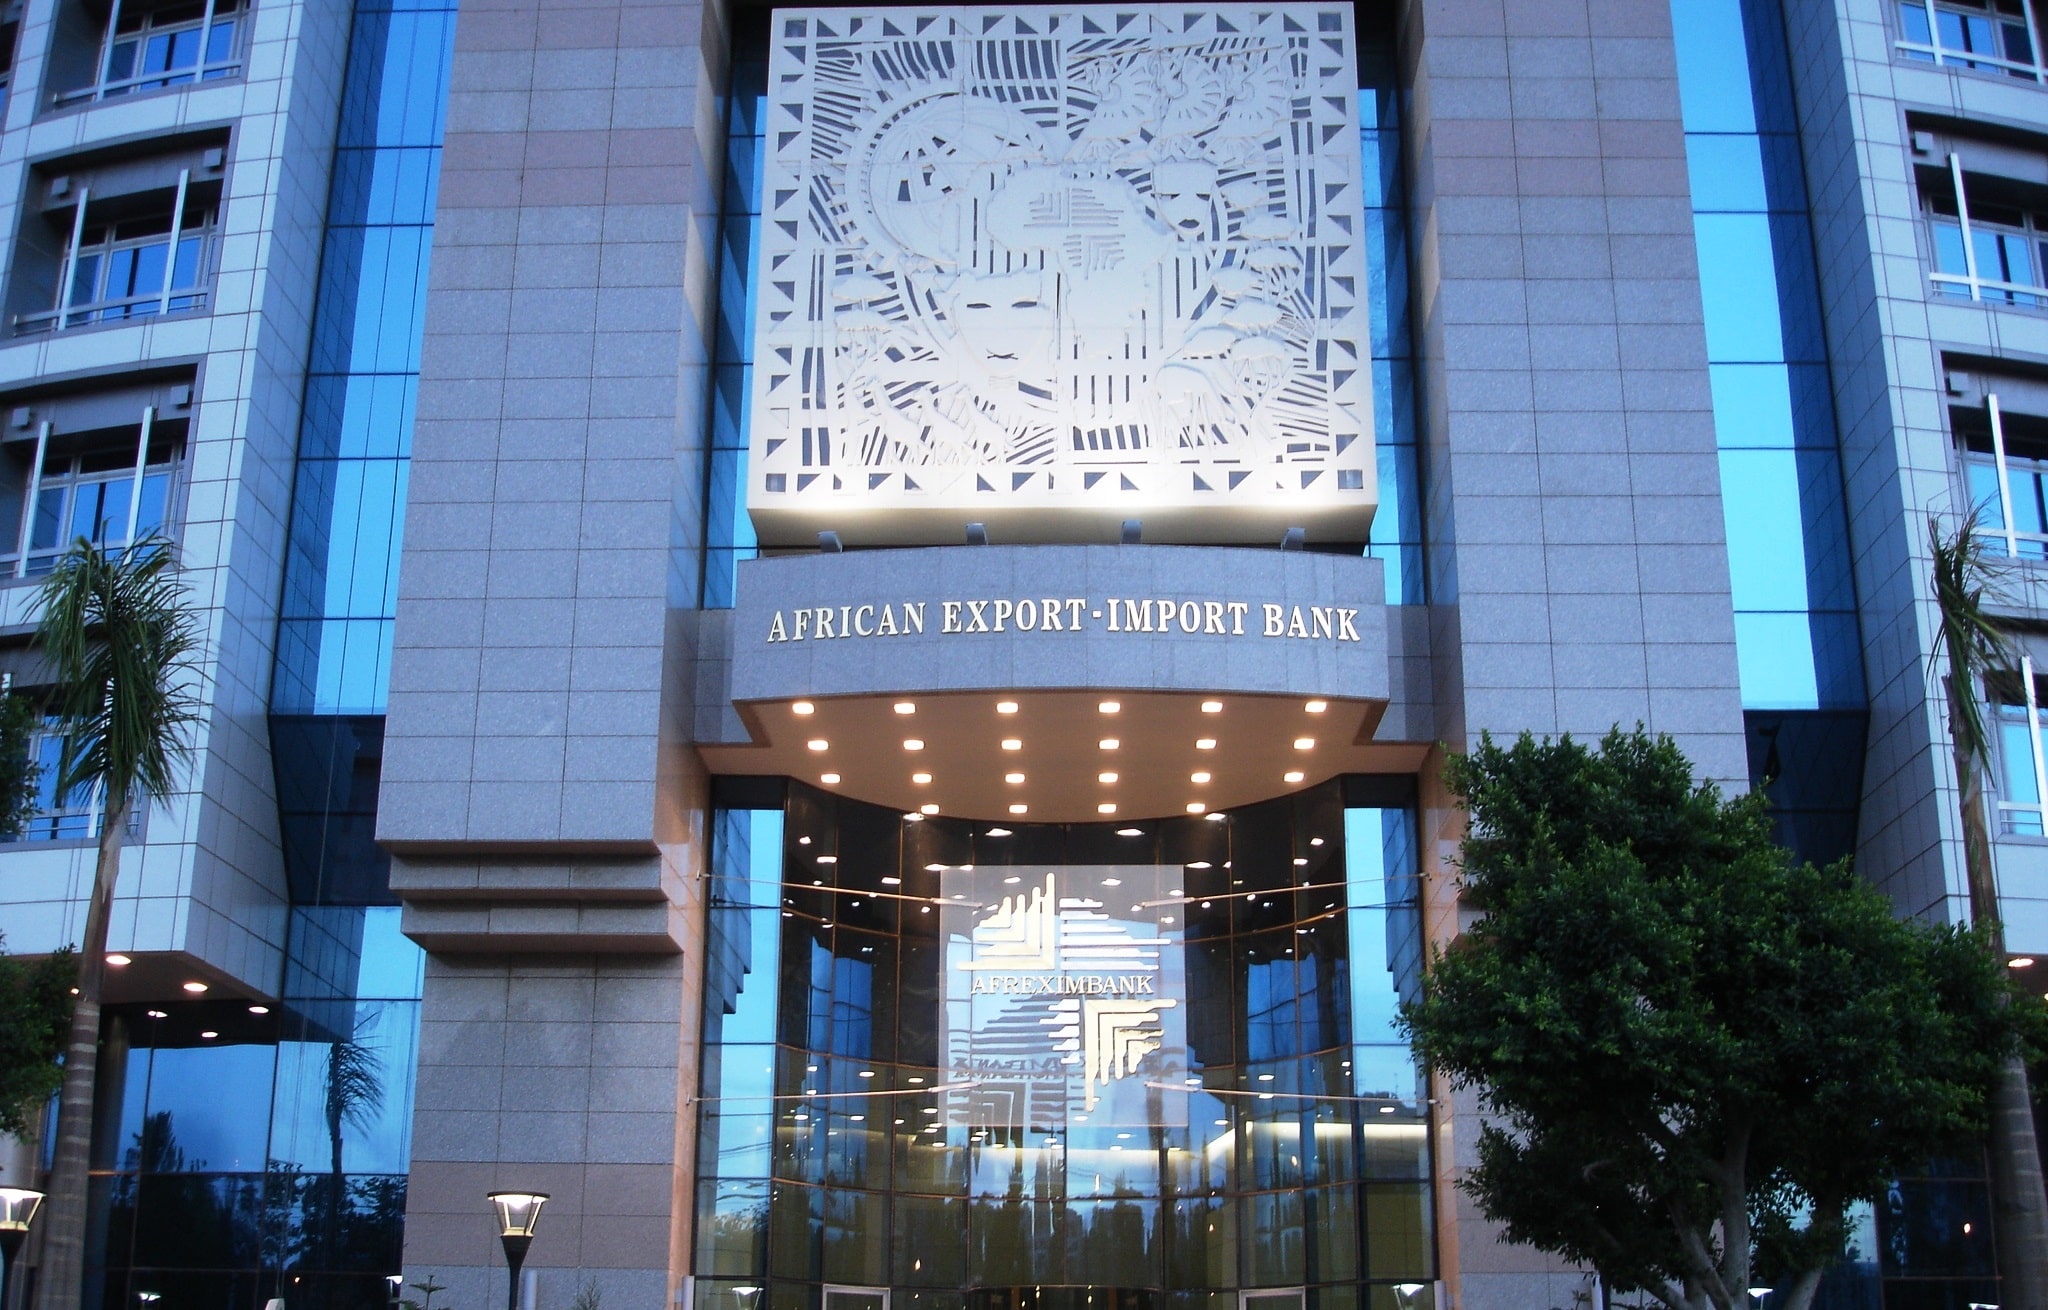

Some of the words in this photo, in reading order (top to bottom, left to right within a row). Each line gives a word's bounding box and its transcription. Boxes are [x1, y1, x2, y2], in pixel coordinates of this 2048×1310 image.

[767, 602, 926, 643] AFRICAN
[941, 598, 1248, 635] EXPORT-IMPORT
[1262, 603, 1361, 642] BANK
[970, 975, 1154, 995] AFREXIMBANK
